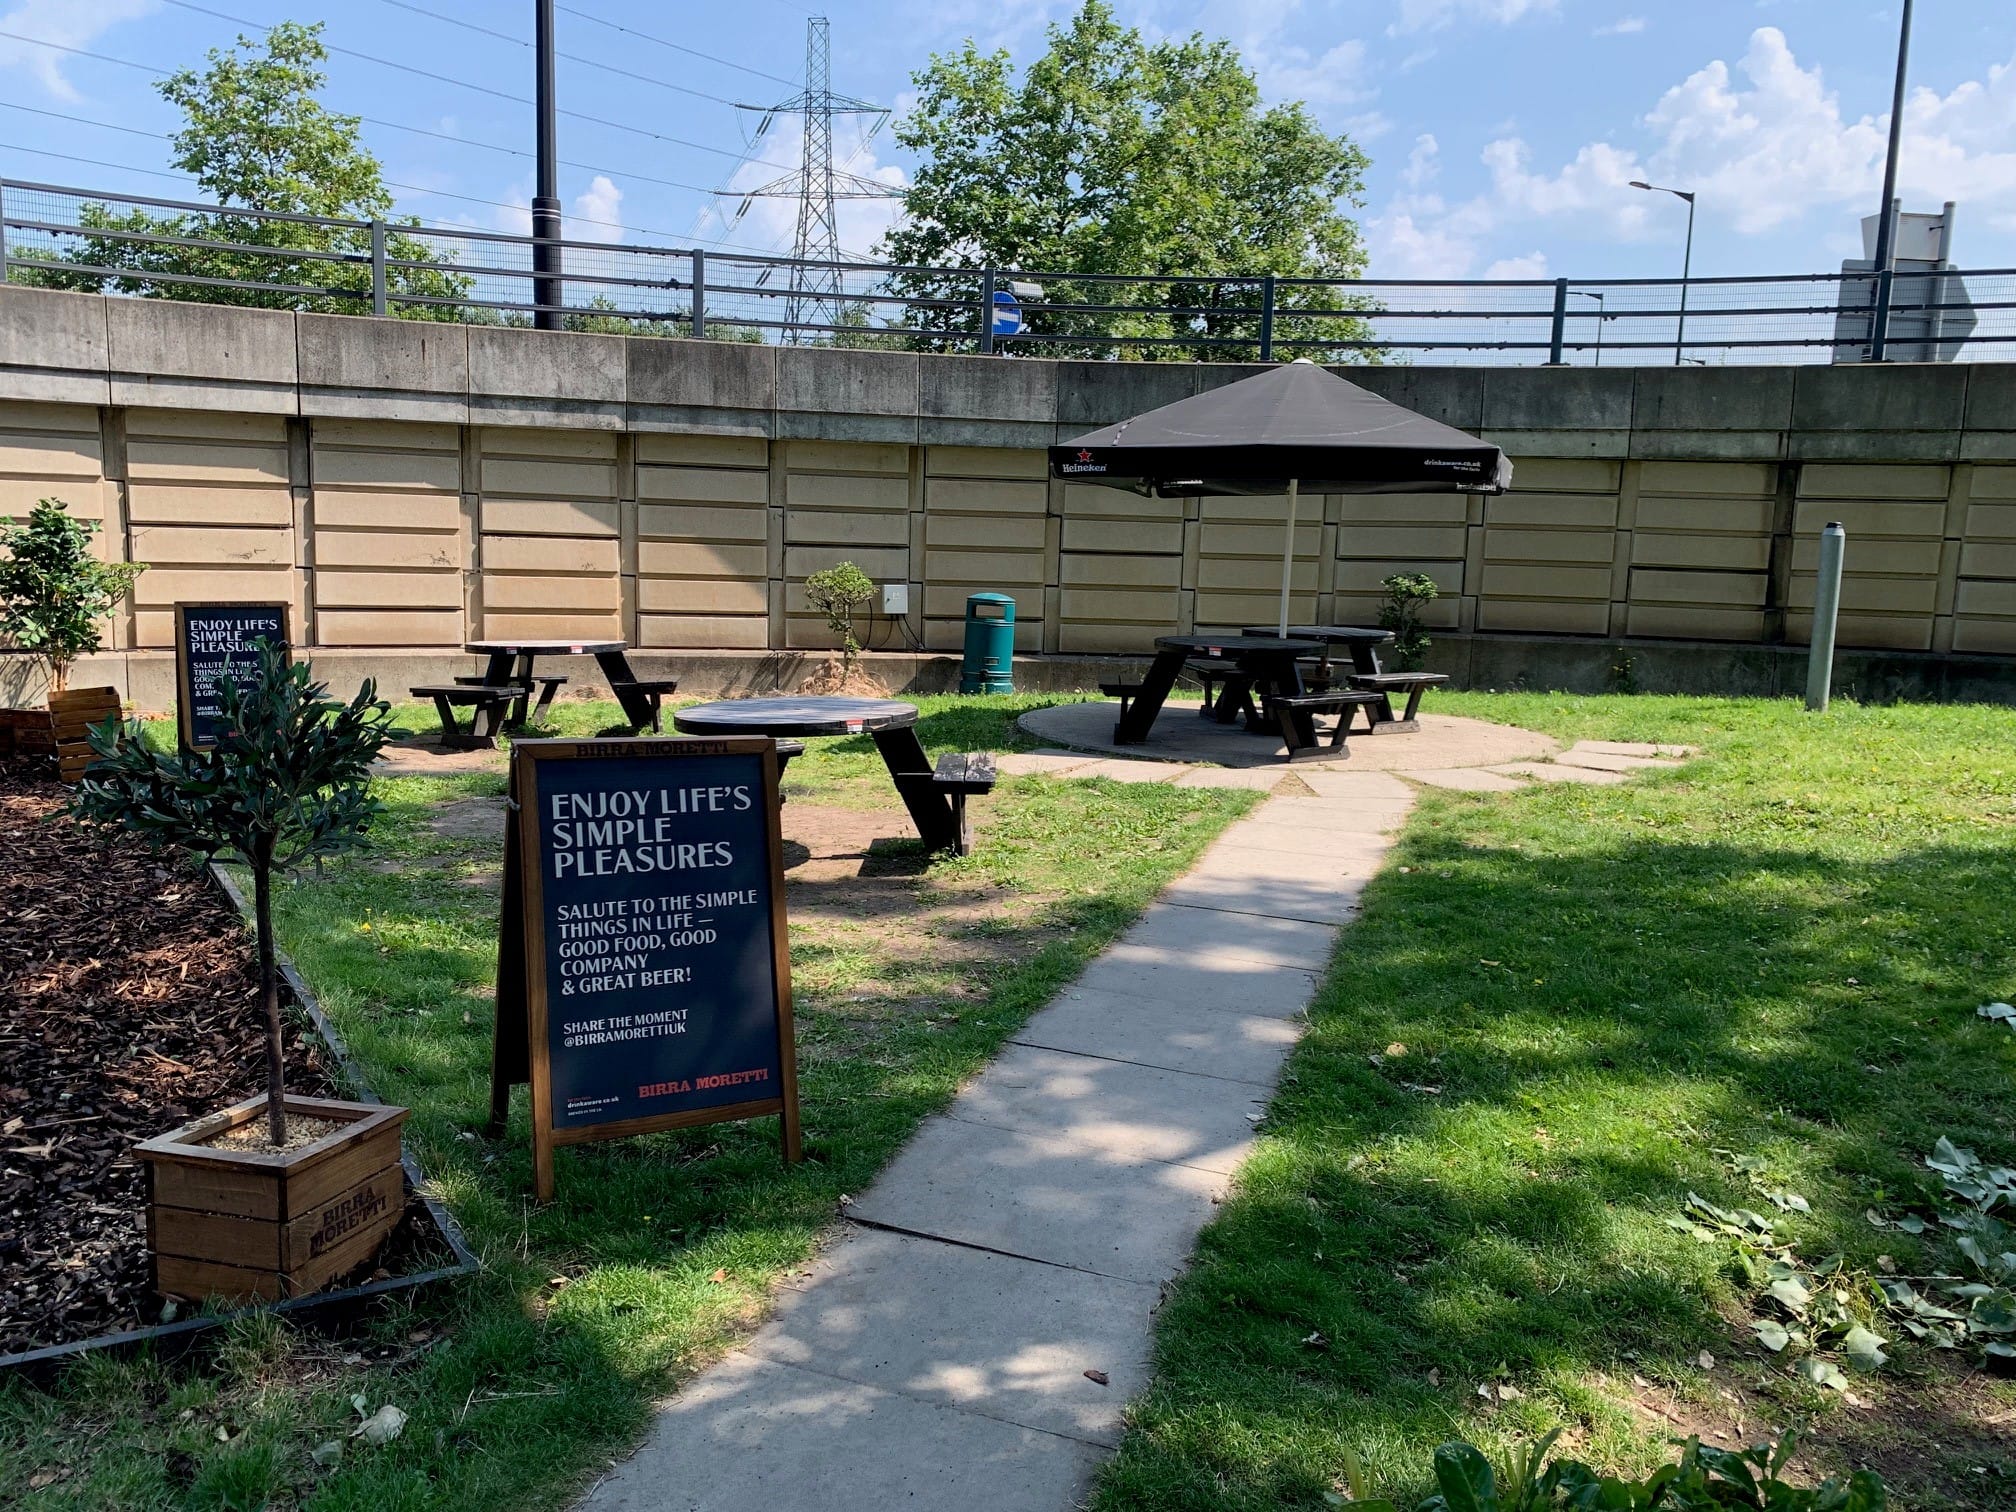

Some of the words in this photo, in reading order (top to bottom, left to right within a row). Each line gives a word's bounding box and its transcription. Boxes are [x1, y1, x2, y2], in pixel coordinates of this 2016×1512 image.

[1062, 463, 1107, 473] Heineken
[190, 619, 233, 631] ENJOY
[236, 619, 278, 631] LIFE'S
[190, 630, 242, 642] SIMPLE
[193, 661, 223, 669] SALUTE
[194, 668, 223, 676] THINGS
[552, 790, 651, 819] ENJOY
[661, 786, 752, 814] LIFE'S
[552, 818, 671, 849] SIMPLE
[554, 841, 733, 878] PLEASURES
[557, 901, 627, 921] SALUTE
[631, 899, 655, 914] TO
[658, 896, 692, 912] THE
[696, 890, 757, 909] SIMPLE
[558, 919, 627, 939] THINGS
[632, 917, 652, 932] IN
[656, 913, 693, 931] LIFE
[559, 938, 609, 958] GOOD
[614, 933, 666, 954] FOOD,
[669, 929, 717, 947] GOOD
[560, 954, 648, 977] COMPANY
[562, 979, 575, 995] &
[579, 974, 635, 993] GREAT
[641, 967, 691, 987] BEER!
[563, 1020, 605, 1035] SHARE
[608, 1016, 632, 1028] THE
[635, 1009, 688, 1026] MOMENT
[564, 1022, 686, 1047] @BIRRAMORETTIUK
[639, 1080, 690, 1099] BIRRA
[696, 1068, 768, 1089] MORETTI
[323, 1186, 376, 1227] BIRRA
[310, 1195, 387, 1257] MORETTI
